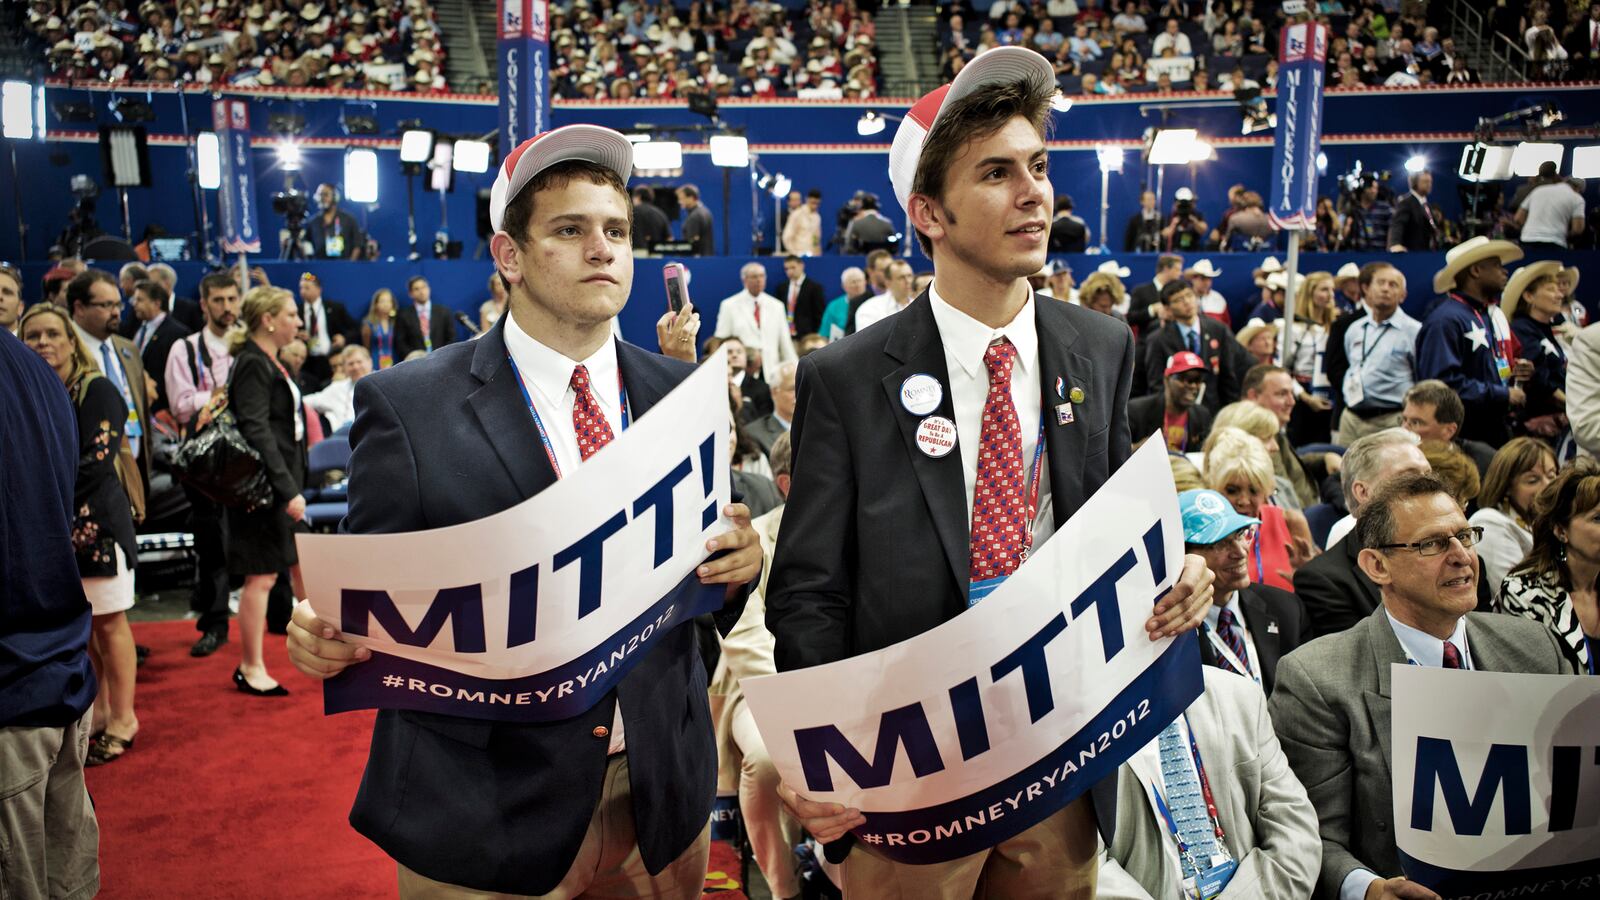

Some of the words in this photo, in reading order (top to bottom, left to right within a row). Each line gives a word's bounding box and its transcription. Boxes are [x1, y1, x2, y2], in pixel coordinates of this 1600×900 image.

[1280, 68, 1301, 211] MINNESOTA
[1305, 68, 1322, 211] MINNESOTA
[918, 434, 953, 448] REPUBLICAN
[923, 422, 941, 431] GREAT
[341, 432, 718, 653] MITT!
[382, 604, 675, 706] #ROMNEYRYAN2012
[793, 518, 1172, 793] MITT!
[864, 699, 1151, 848] #ROMNEYRYAN2012
[1410, 736, 1600, 836] MI
